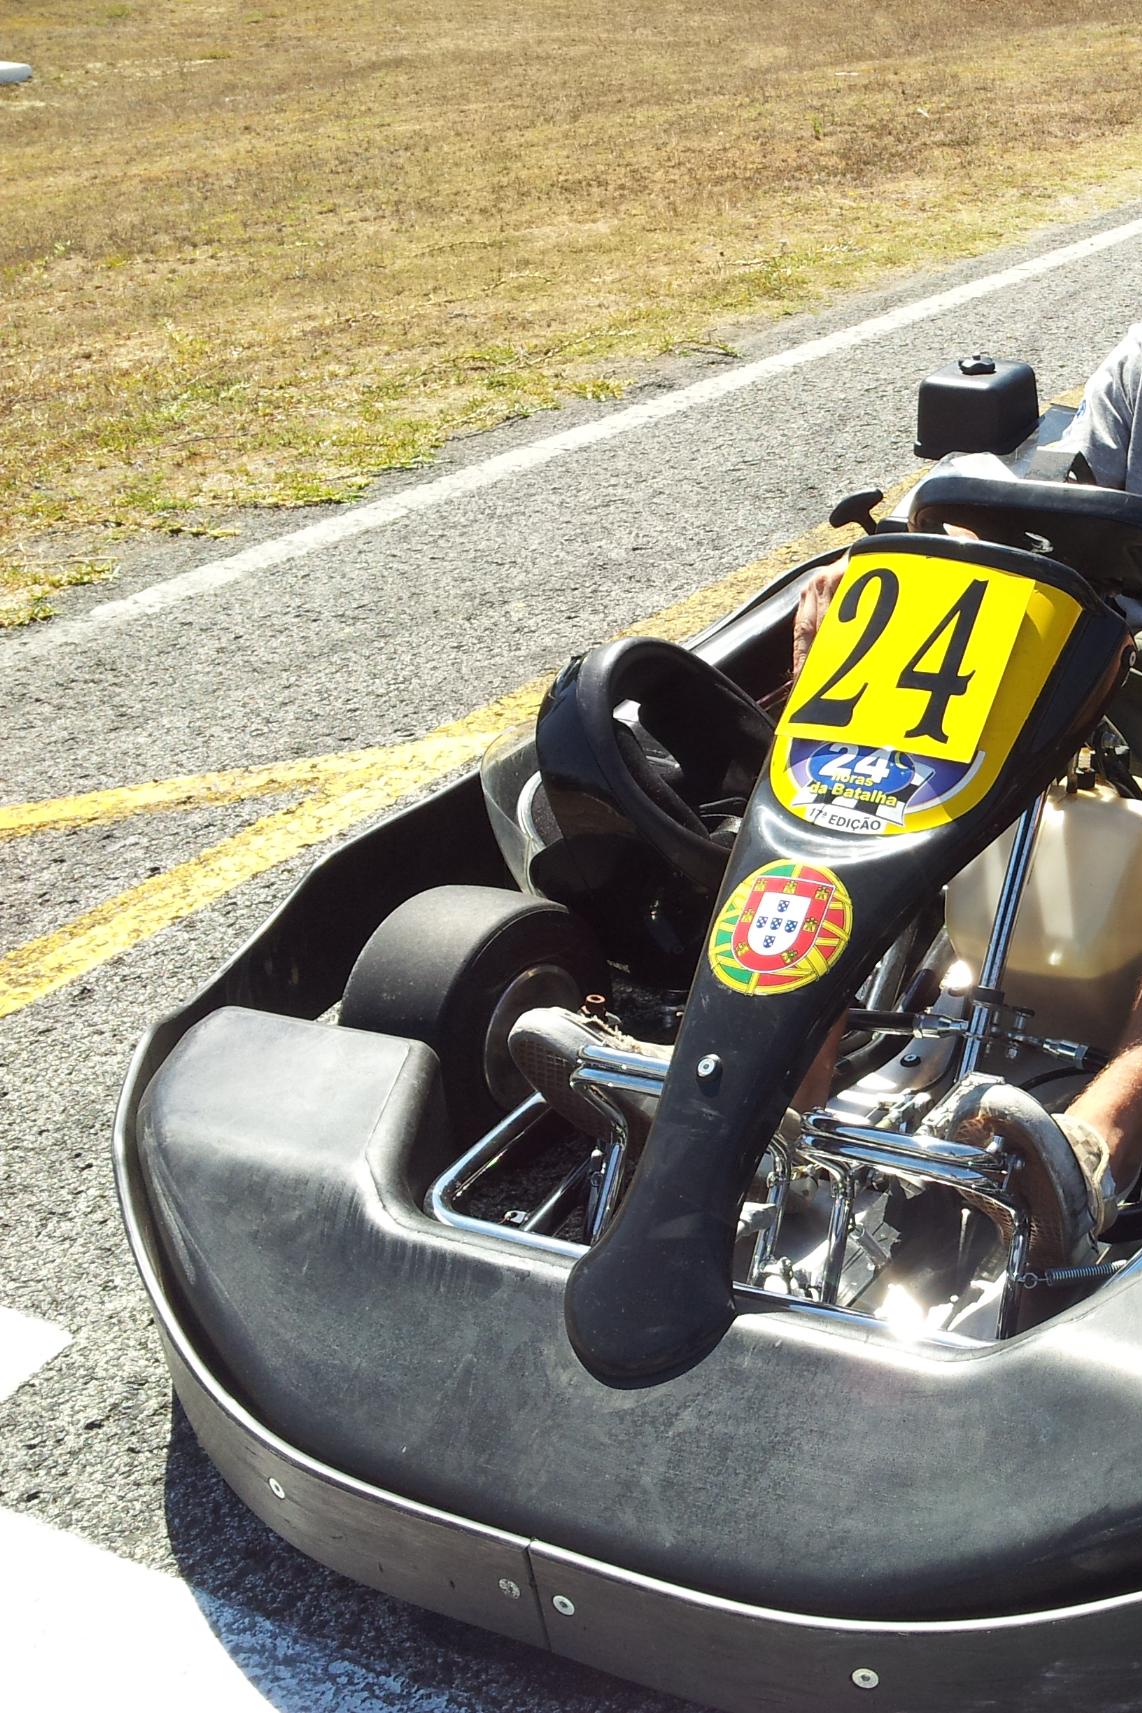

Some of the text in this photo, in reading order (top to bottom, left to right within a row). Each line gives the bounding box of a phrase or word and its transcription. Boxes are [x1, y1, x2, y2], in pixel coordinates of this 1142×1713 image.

[789, 567, 989, 745] 24
[818, 743, 892, 783] 24
[808, 782, 898, 807] da Batalha
[828, 814, 882, 831] EDIÇÃO
